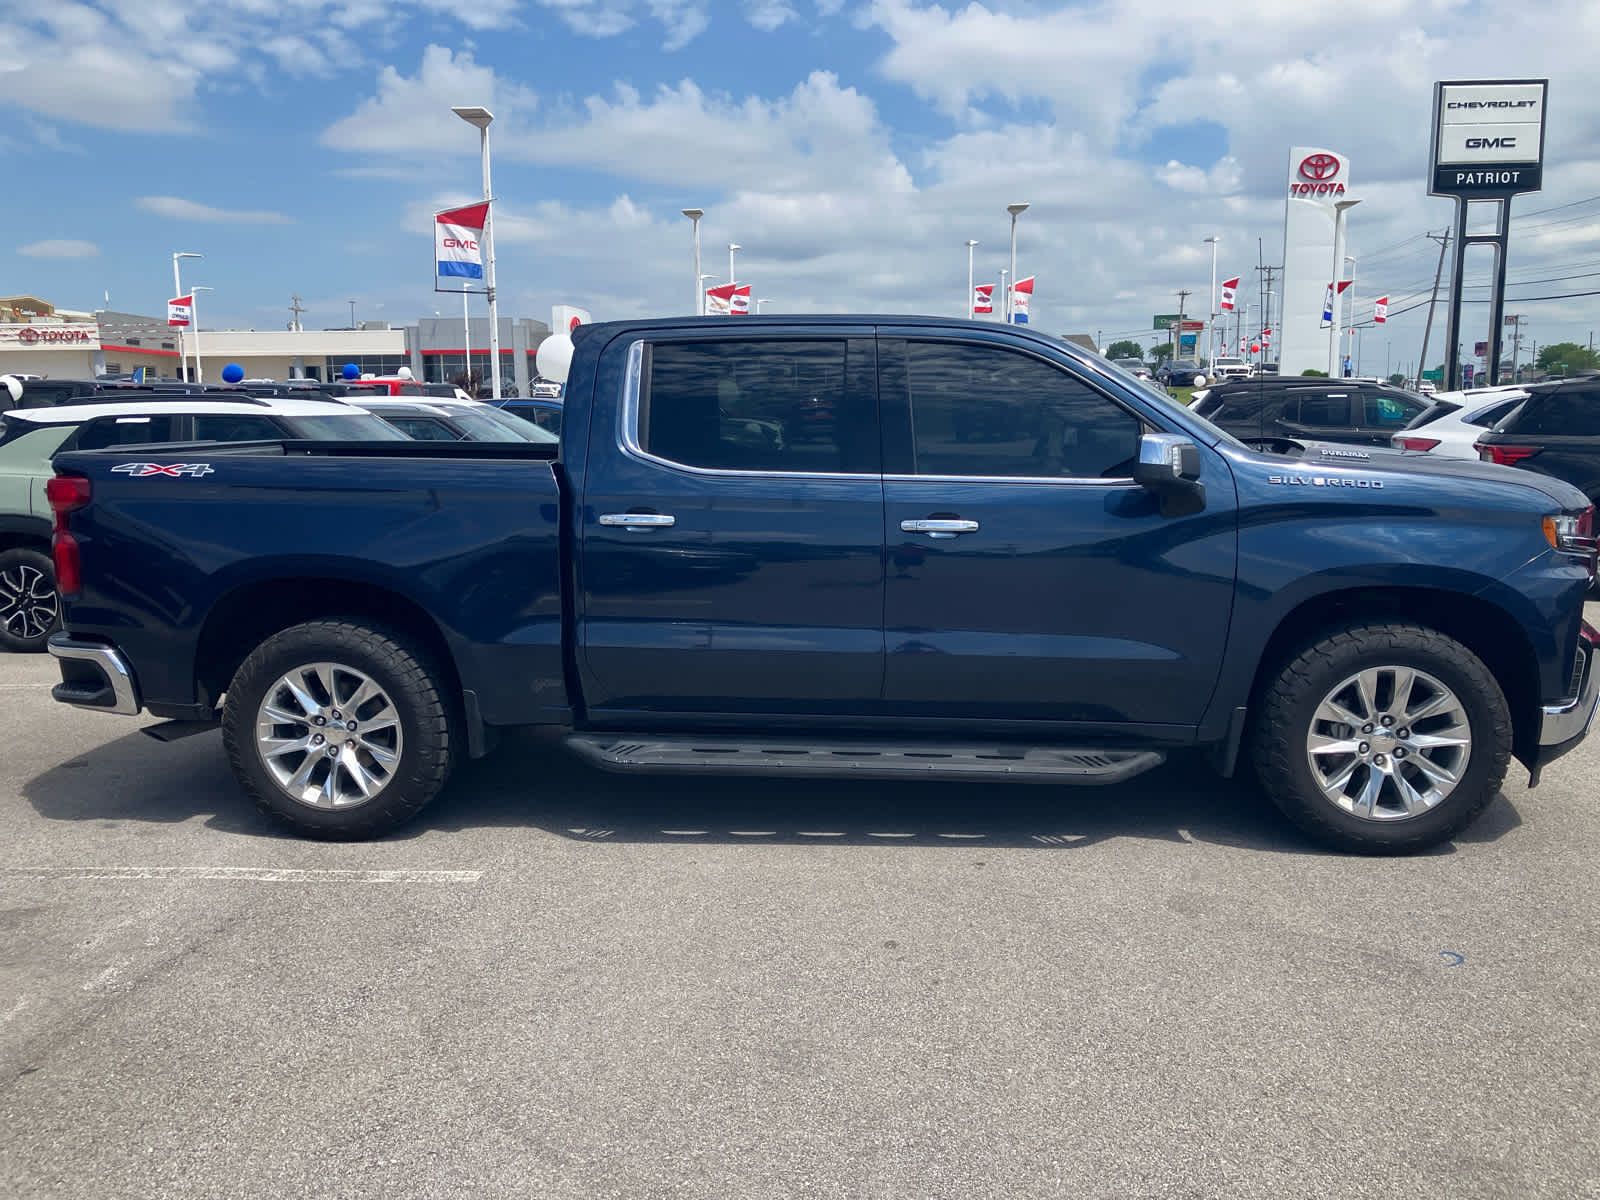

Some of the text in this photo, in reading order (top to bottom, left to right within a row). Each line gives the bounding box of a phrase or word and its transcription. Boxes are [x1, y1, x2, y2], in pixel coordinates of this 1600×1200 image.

[1447, 101, 1536, 109] CHEVROLET
[1465, 138, 1516, 148] GMC
[1456, 172, 1520, 184] PATRIOT
[1291, 183, 1345, 194] TOYOTA
[443, 238, 478, 250] GMC
[41, 330, 89, 341] TOYOTA
[1321, 449, 1370, 458] DURAMAX
[1267, 475, 1384, 489] SILVERADO
